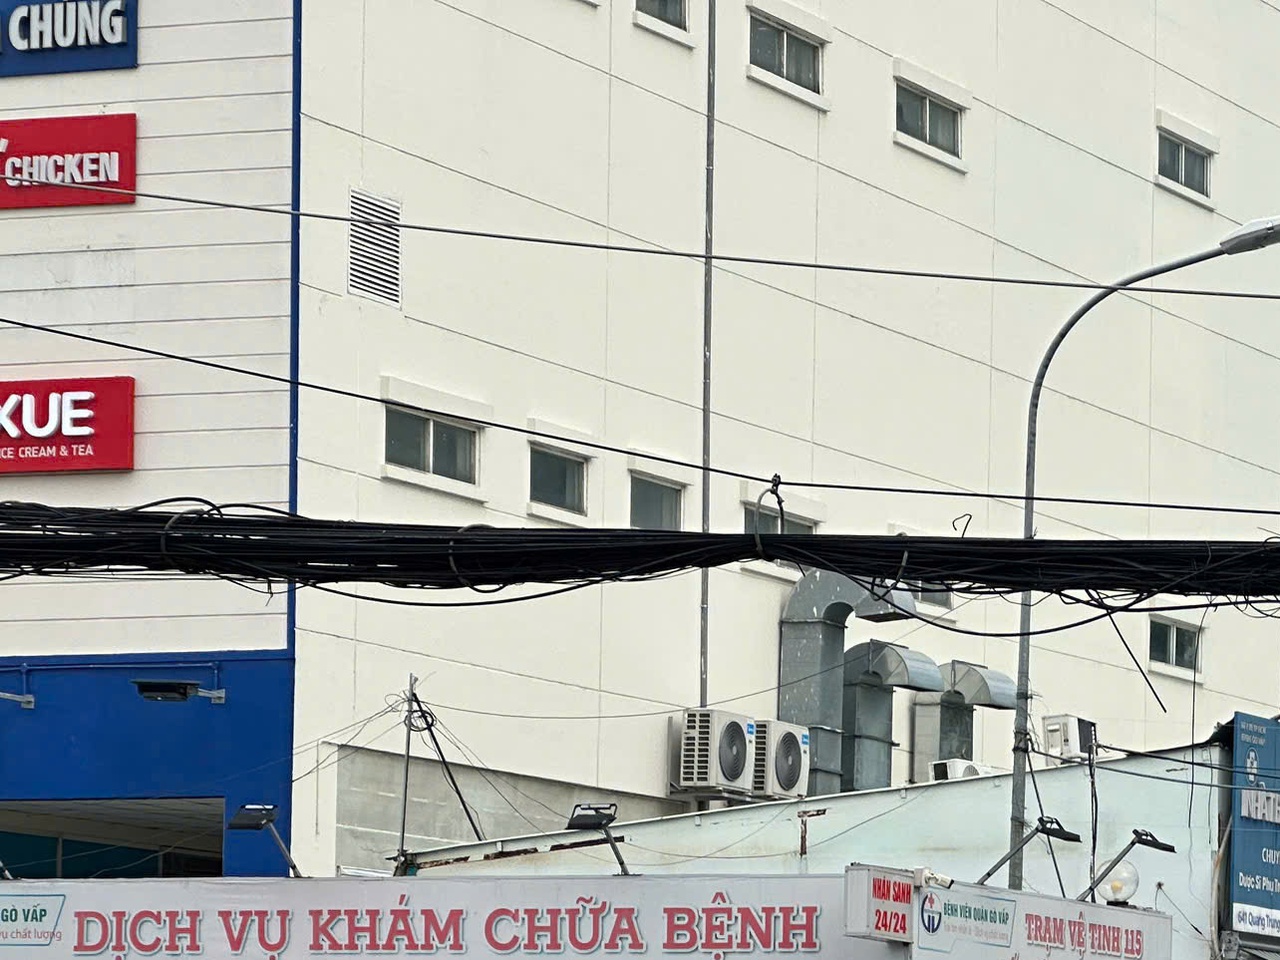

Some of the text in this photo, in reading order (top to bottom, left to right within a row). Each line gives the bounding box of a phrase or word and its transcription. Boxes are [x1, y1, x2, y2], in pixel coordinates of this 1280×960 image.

[8, 1, 127, 51] CHUNG
[4, 152, 120, 187] CHICKEN
[18, 444, 94, 458] CREAM & TEA
[1, 903, 47, 922] GÒ VẤP
[309, 894, 464, 951] KHÁM
[484, 896, 645, 952] CHỮA
[875, 909, 907, 934] 24/24
[1025, 913, 1065, 955] TRẠM
[1068, 911, 1086, 959] VỆ
[1124, 929, 1143, 958] 115
